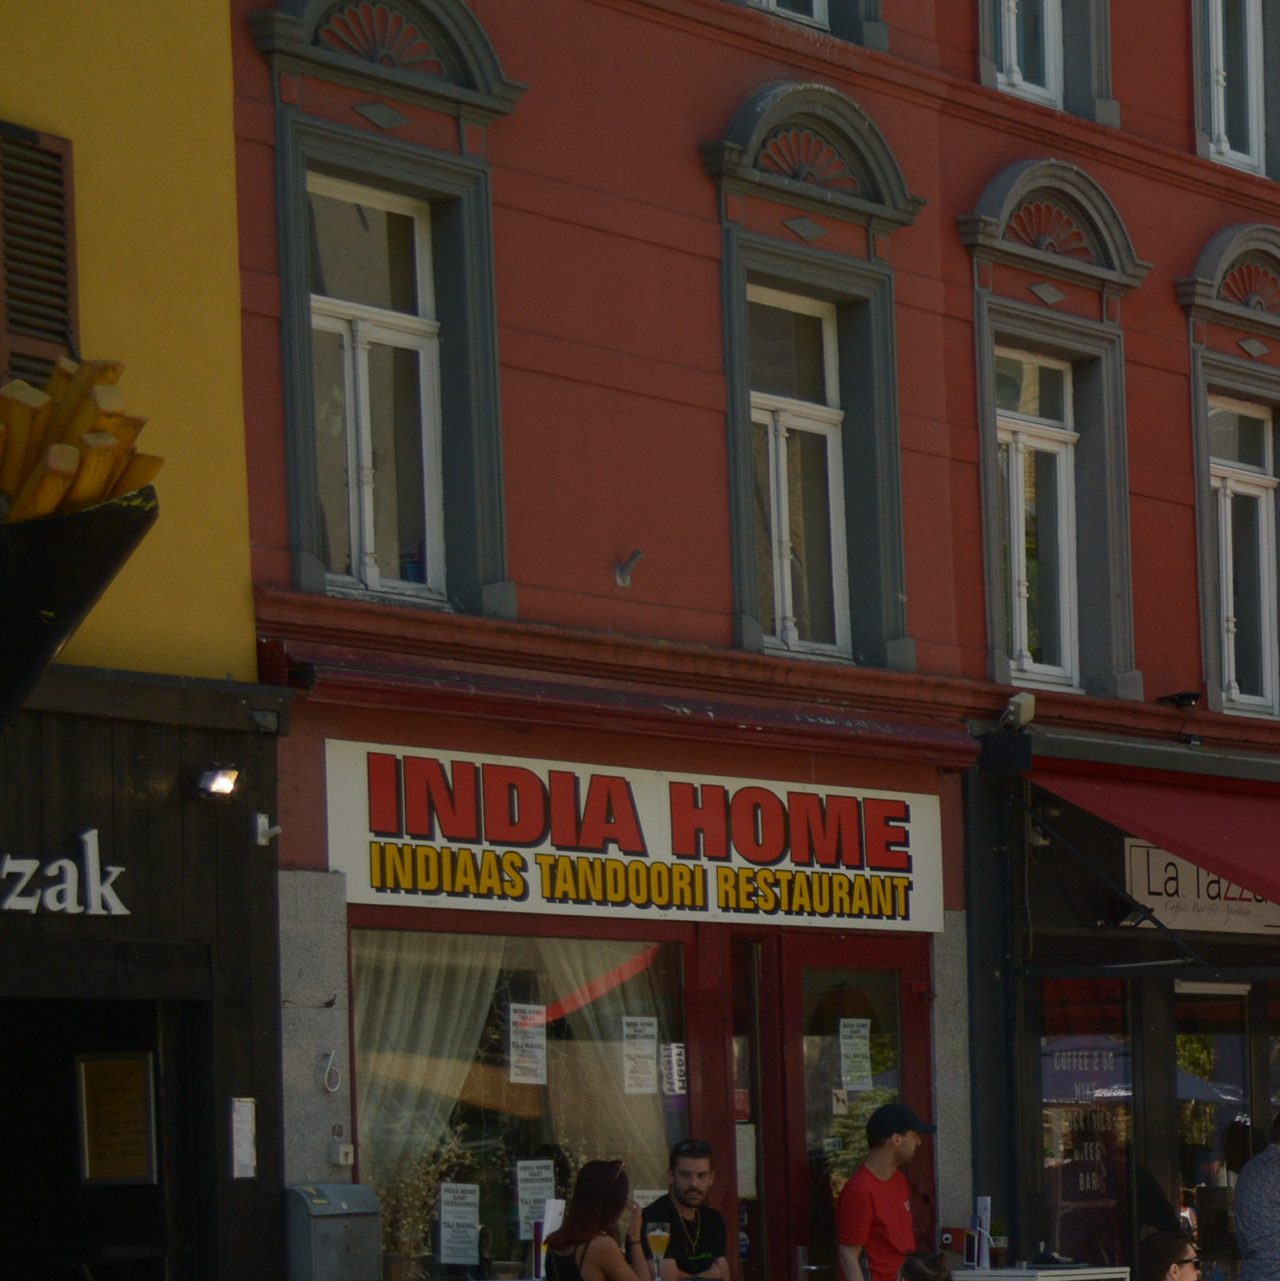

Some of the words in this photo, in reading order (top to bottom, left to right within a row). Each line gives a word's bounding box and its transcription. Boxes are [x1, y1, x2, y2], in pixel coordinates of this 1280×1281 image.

[367, 752, 648, 857] INDIA
[669, 781, 912, 872] HOME
[1, 829, 131, 915] zak
[369, 842, 528, 900] INDIAAS
[535, 854, 706, 909] TANDOORI
[716, 866, 911, 921] RESTAURANT
[1146, 849, 1180, 898] La
[324, 1050, 341, 1092] 6
[1055, 1052, 1090, 1071] COFFEE
[1093, 1052, 1099, 1071] 2
[1103, 1052, 1115, 1071] GO
[1074, 1082, 1097, 1100] WINE
[1079, 1172, 1098, 1191] BAR
